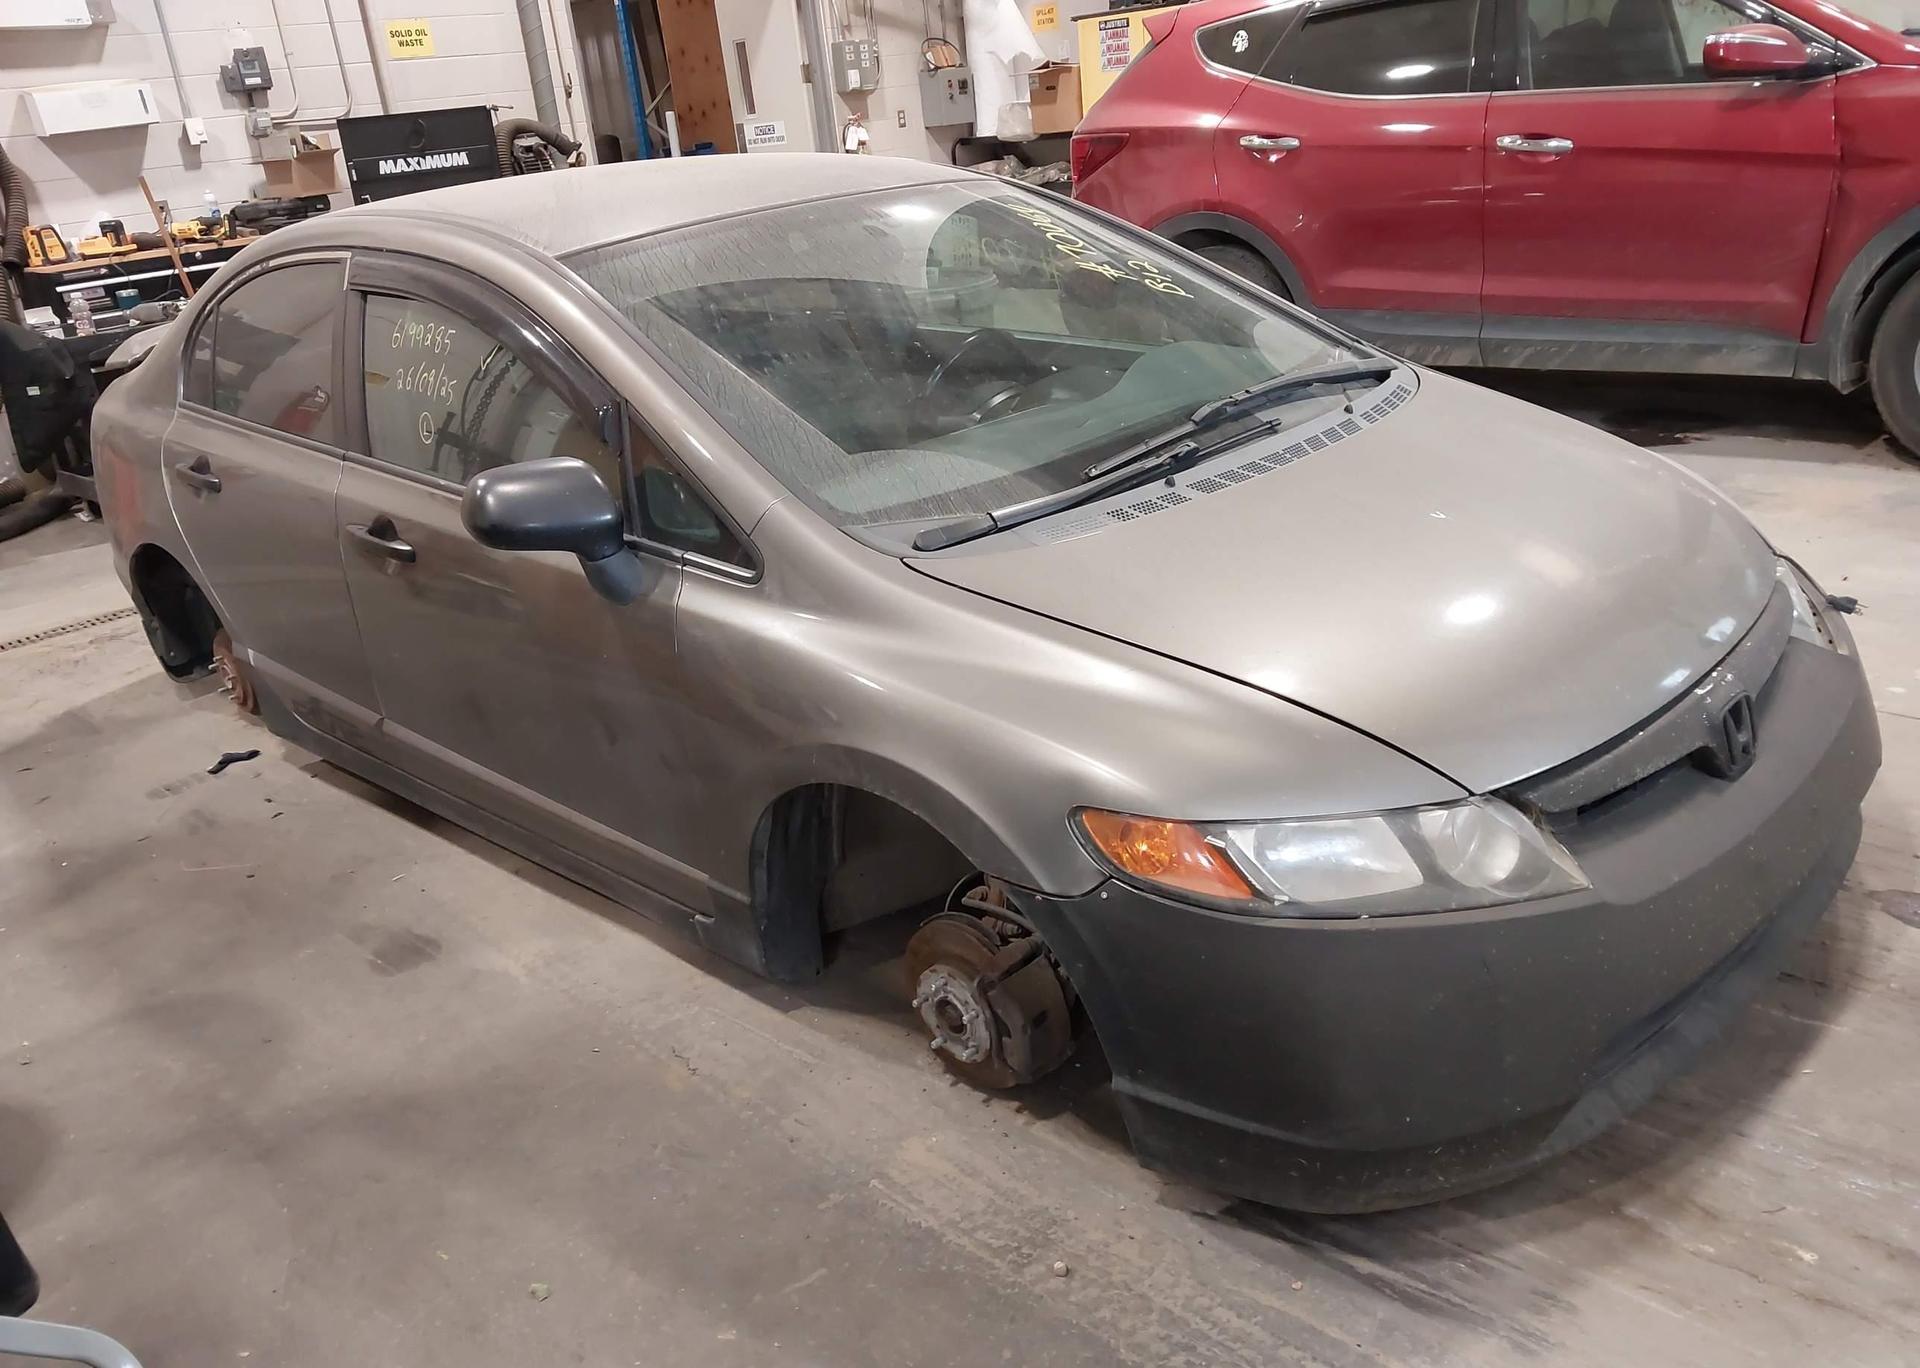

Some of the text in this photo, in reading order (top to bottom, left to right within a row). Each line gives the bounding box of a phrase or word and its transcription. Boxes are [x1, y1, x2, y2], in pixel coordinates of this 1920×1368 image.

[389, 28, 428, 38] SOLID OIL
[397, 38, 424, 47] WASTE
[754, 125, 775, 136] NOTICE
[379, 152, 470, 174] MAXIMUM
[76, 320, 90, 329] G2
[391, 319, 456, 355] 6199285
